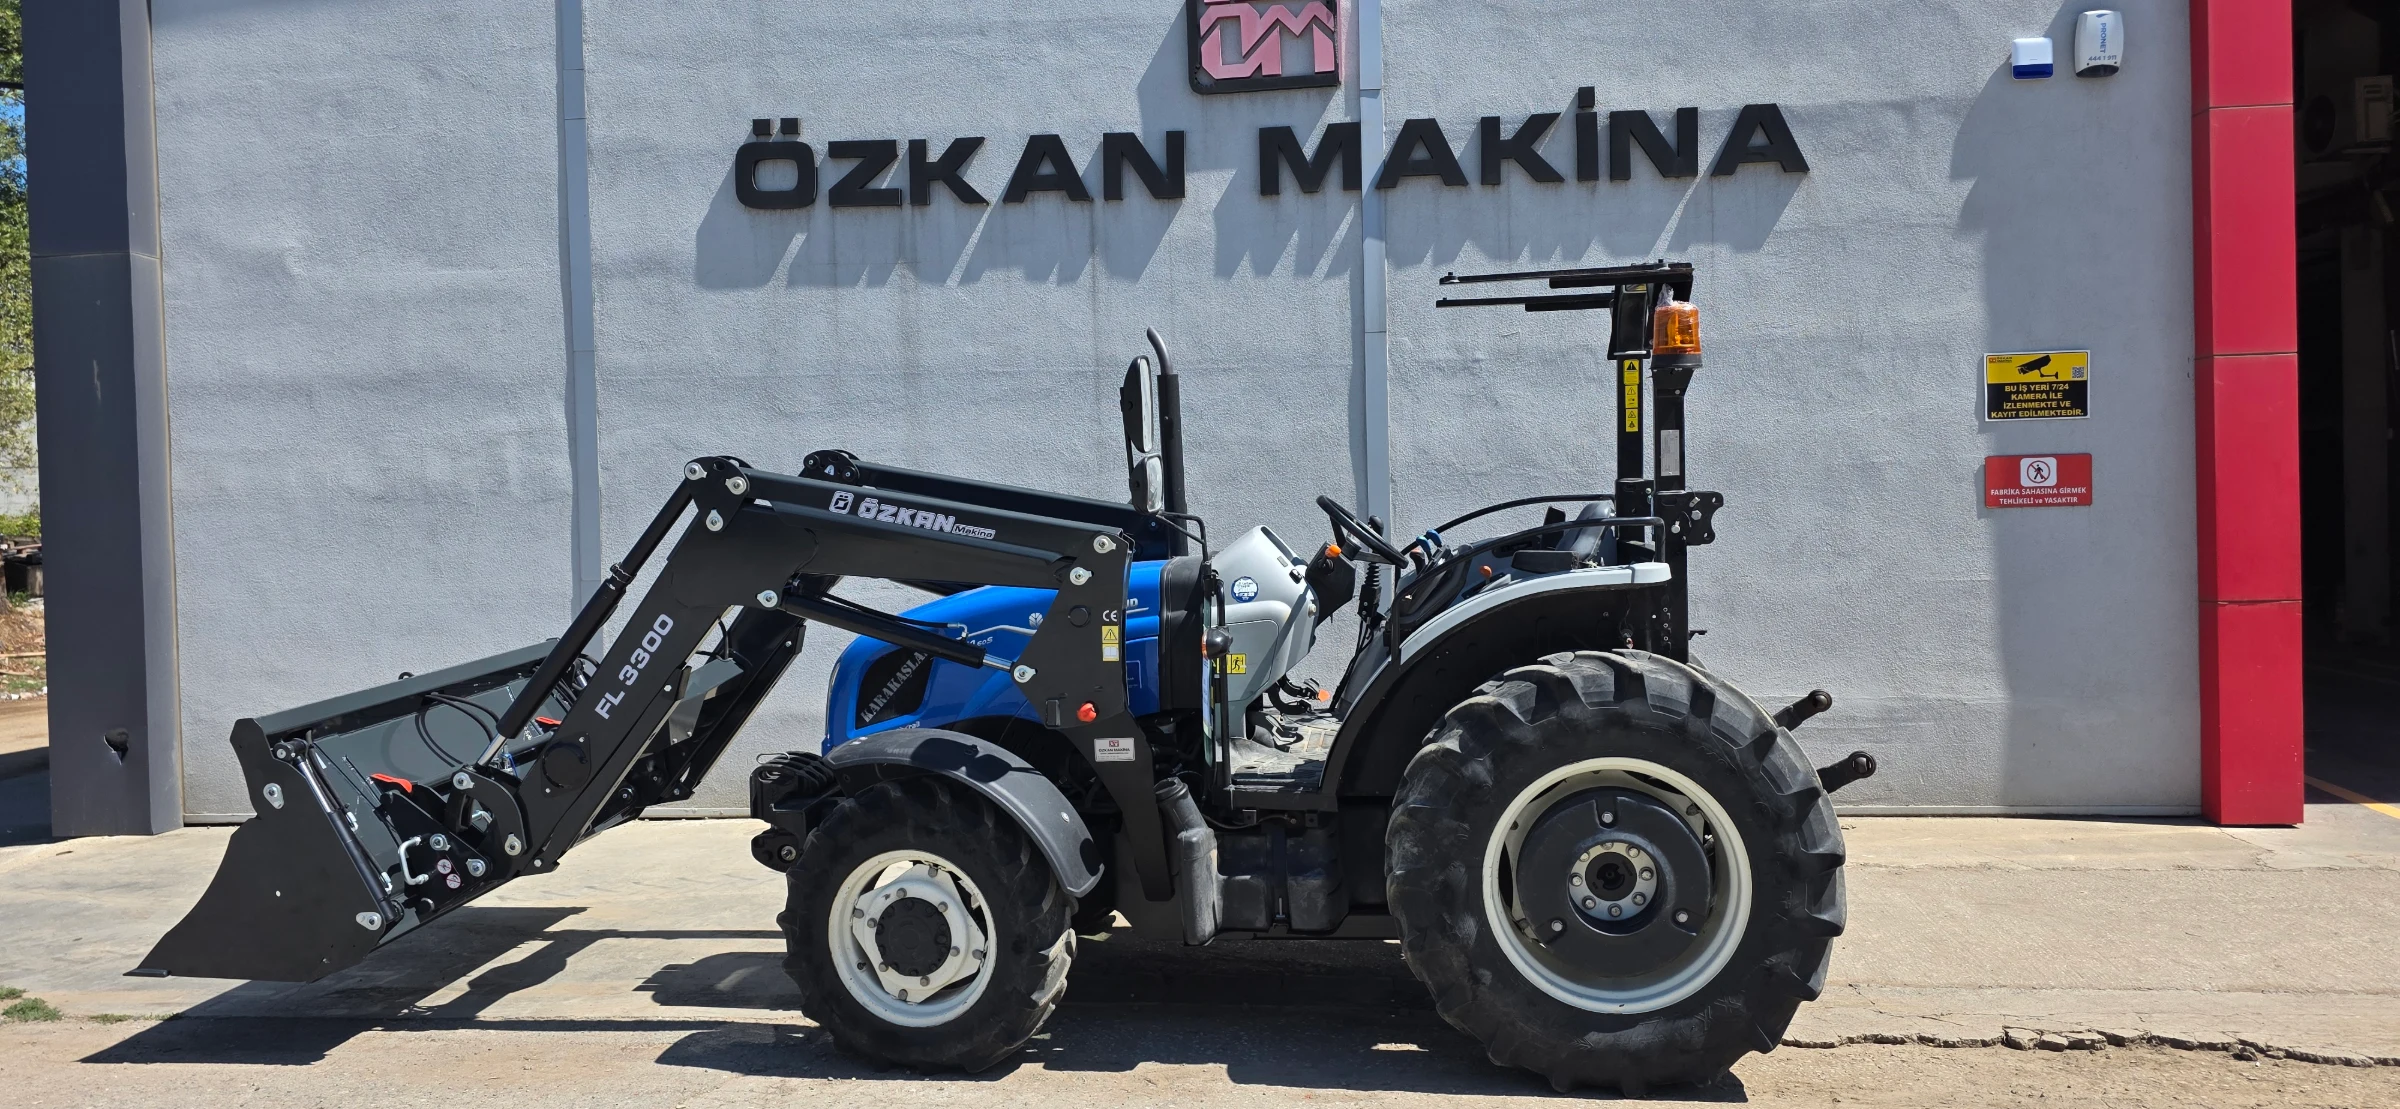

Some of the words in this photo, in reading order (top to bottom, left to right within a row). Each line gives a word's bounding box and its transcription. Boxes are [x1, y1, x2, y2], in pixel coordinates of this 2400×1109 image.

[735, 117, 1185, 209] ÖZKAN
[1259, 86, 1811, 196] MAKİNA
[2019, 384, 2027, 392] İŞ
[2030, 383, 2050, 391] YERİ
[2003, 401, 2057, 409] İZLENMEKTE
[2019, 408, 2084, 417] EDİLMEKTEDİR.
[2059, 486, 2087, 494] GİRMEK
[857, 497, 956, 533] ÖZKAN
[953, 525, 994, 539] Makina
[1102, 609, 1118, 622] CE
[594, 690, 626, 720] FL
[618, 613, 674, 686] 3300
[860, 651, 929, 723] KARAKAŞLA
